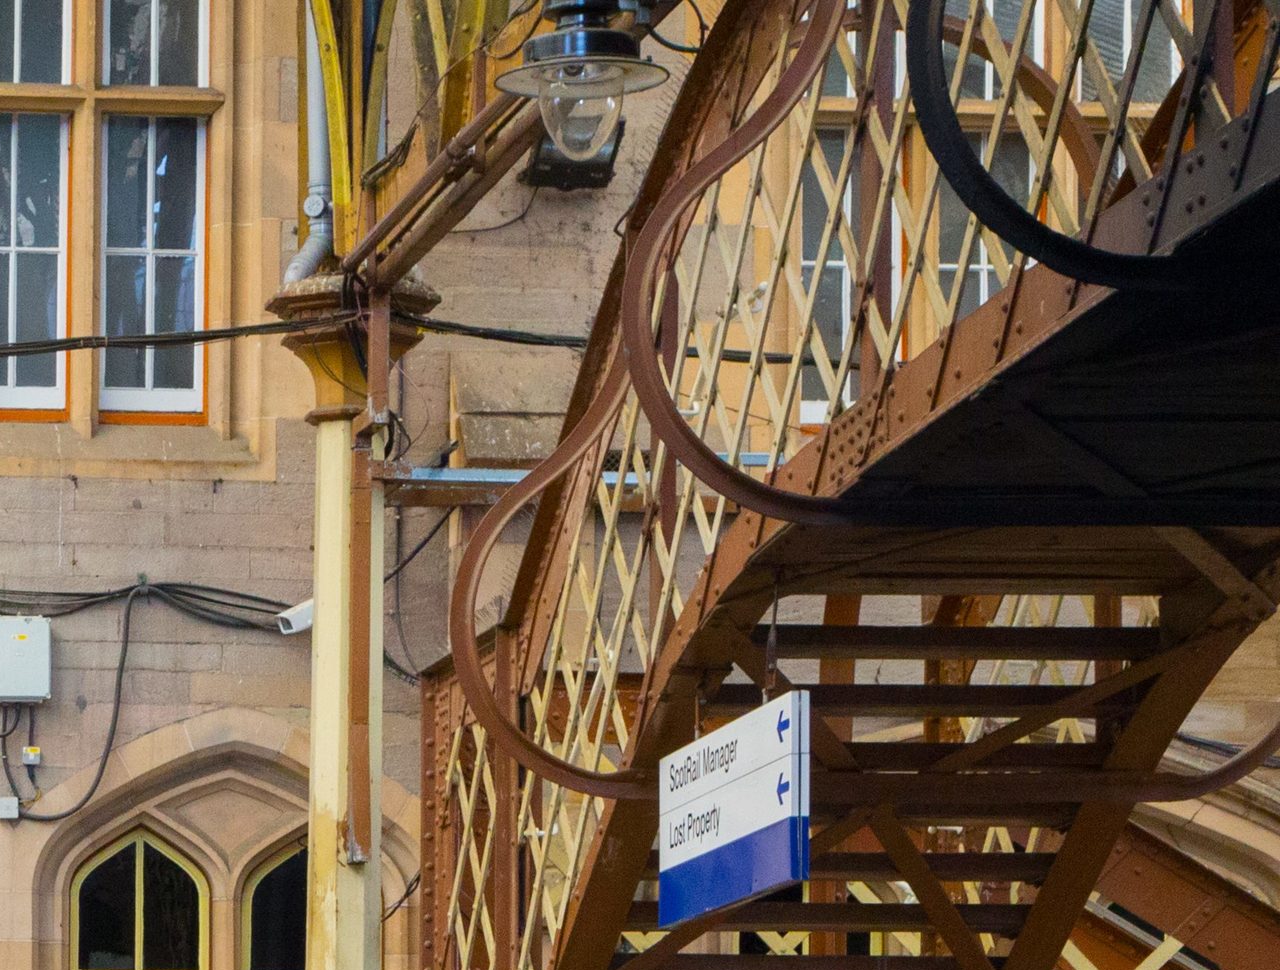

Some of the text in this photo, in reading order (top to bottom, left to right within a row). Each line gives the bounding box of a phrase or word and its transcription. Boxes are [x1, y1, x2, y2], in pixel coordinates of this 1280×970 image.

[670, 739, 738, 792] ScotRail Manager
[670, 804, 720, 849] Lost Property
